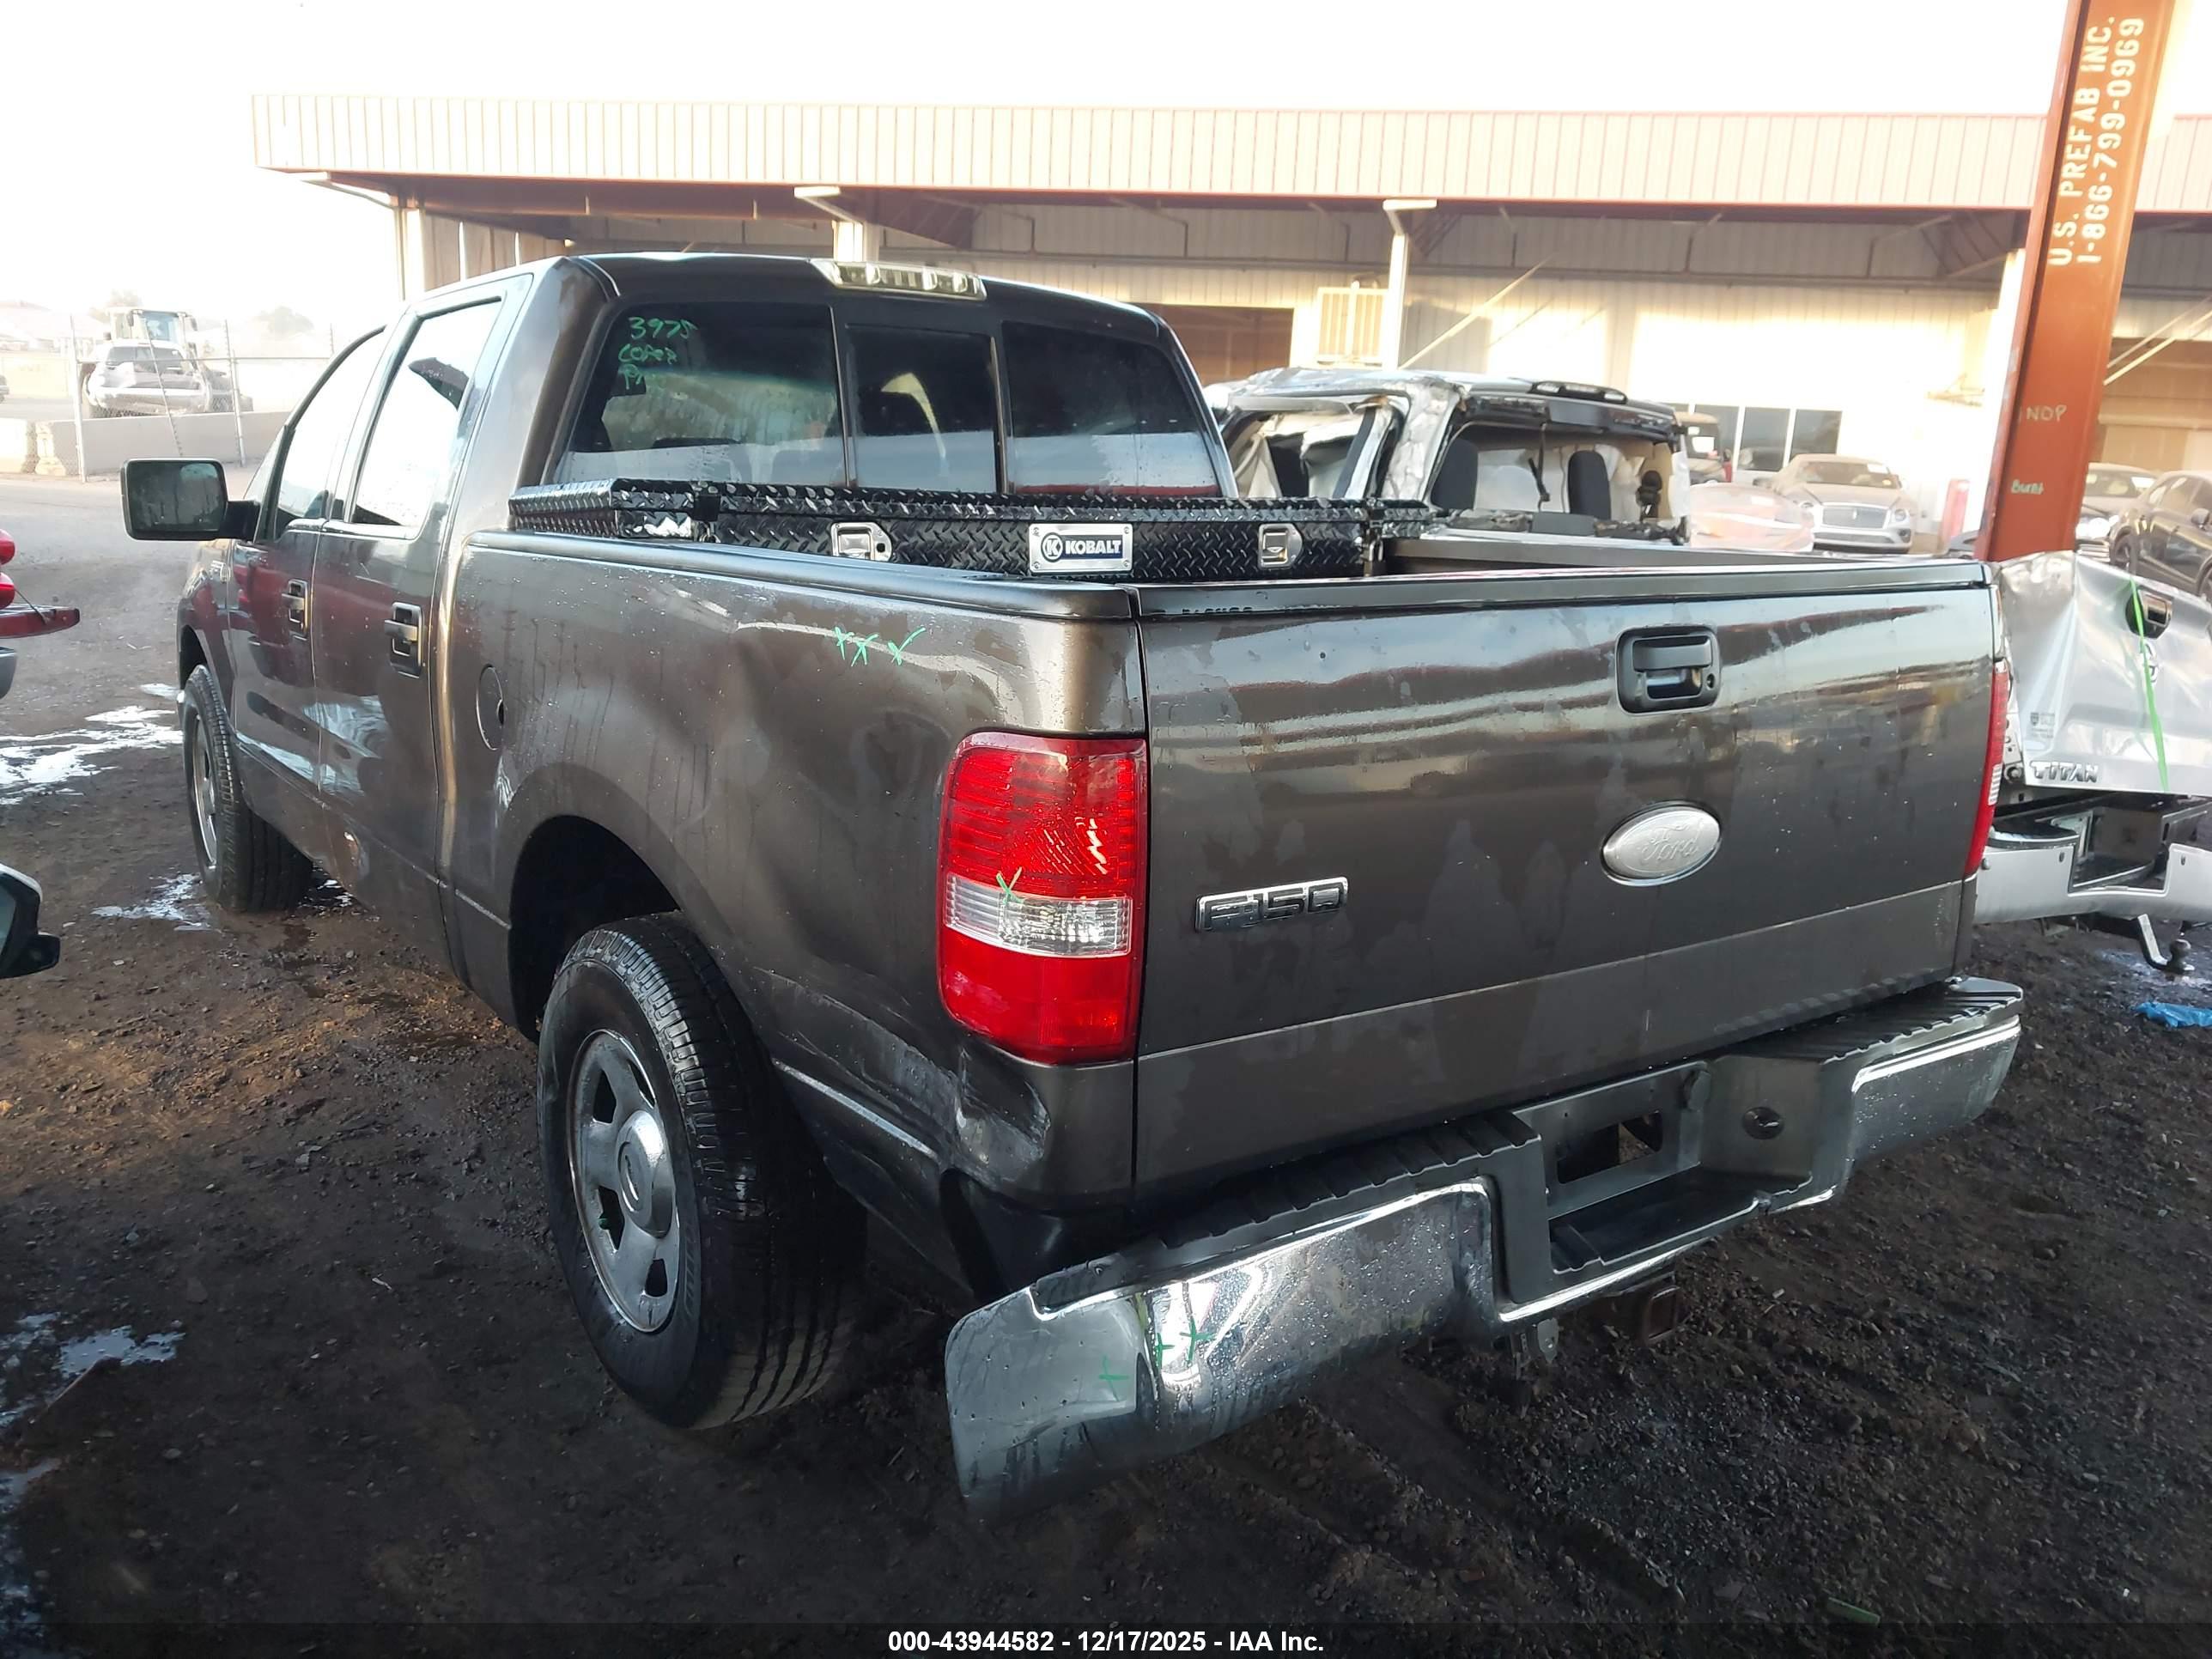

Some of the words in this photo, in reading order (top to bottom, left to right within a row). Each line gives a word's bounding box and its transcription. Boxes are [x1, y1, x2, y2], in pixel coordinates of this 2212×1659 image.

[2079, 16, 2115, 72] INC.
[2058, 88, 2100, 197] PREFAB
[2076, 18, 2144, 264] 1-866-799-0969
[2047, 213, 2080, 266] U.S.
[1065, 540, 1121, 555] KOBALT
[2029, 760, 2099, 783] TITAN
[1637, 818, 1703, 860] Ford
